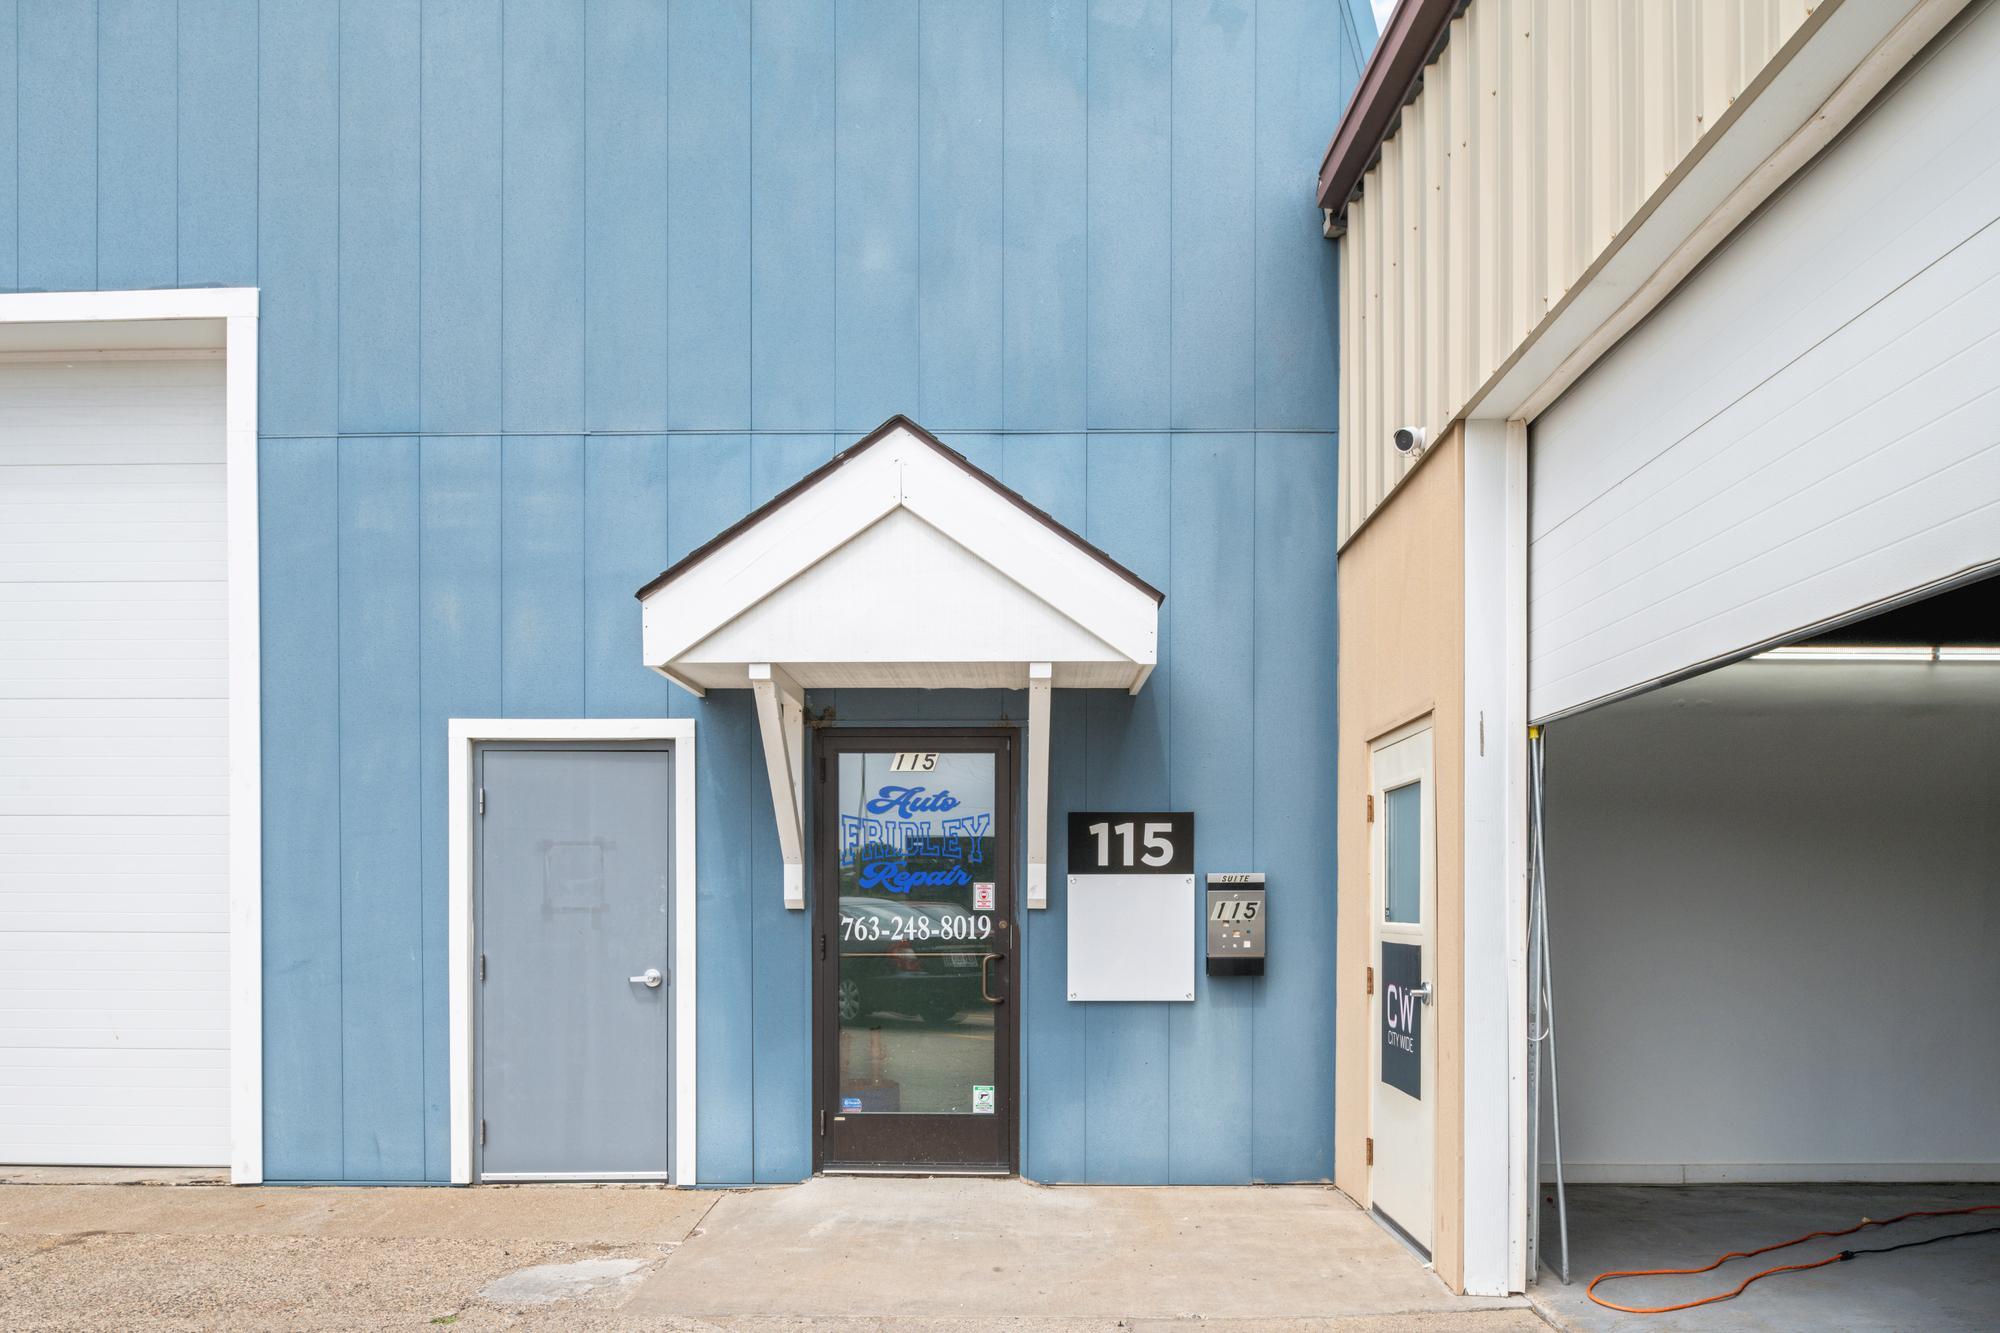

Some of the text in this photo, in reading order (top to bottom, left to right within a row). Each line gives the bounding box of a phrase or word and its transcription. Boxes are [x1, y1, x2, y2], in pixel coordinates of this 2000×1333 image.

[896, 753, 936, 771] 115
[866, 785, 961, 819] Auto
[841, 813, 991, 866] FRIDLEY
[1089, 822, 1174, 867] 115
[859, 861, 973, 893] Repair
[1217, 902, 1258, 919] 115
[841, 915, 991, 941] 763-248-8019
[1387, 984, 1415, 1034] CW
[1387, 1030, 1414, 1053] CITY WIDE
